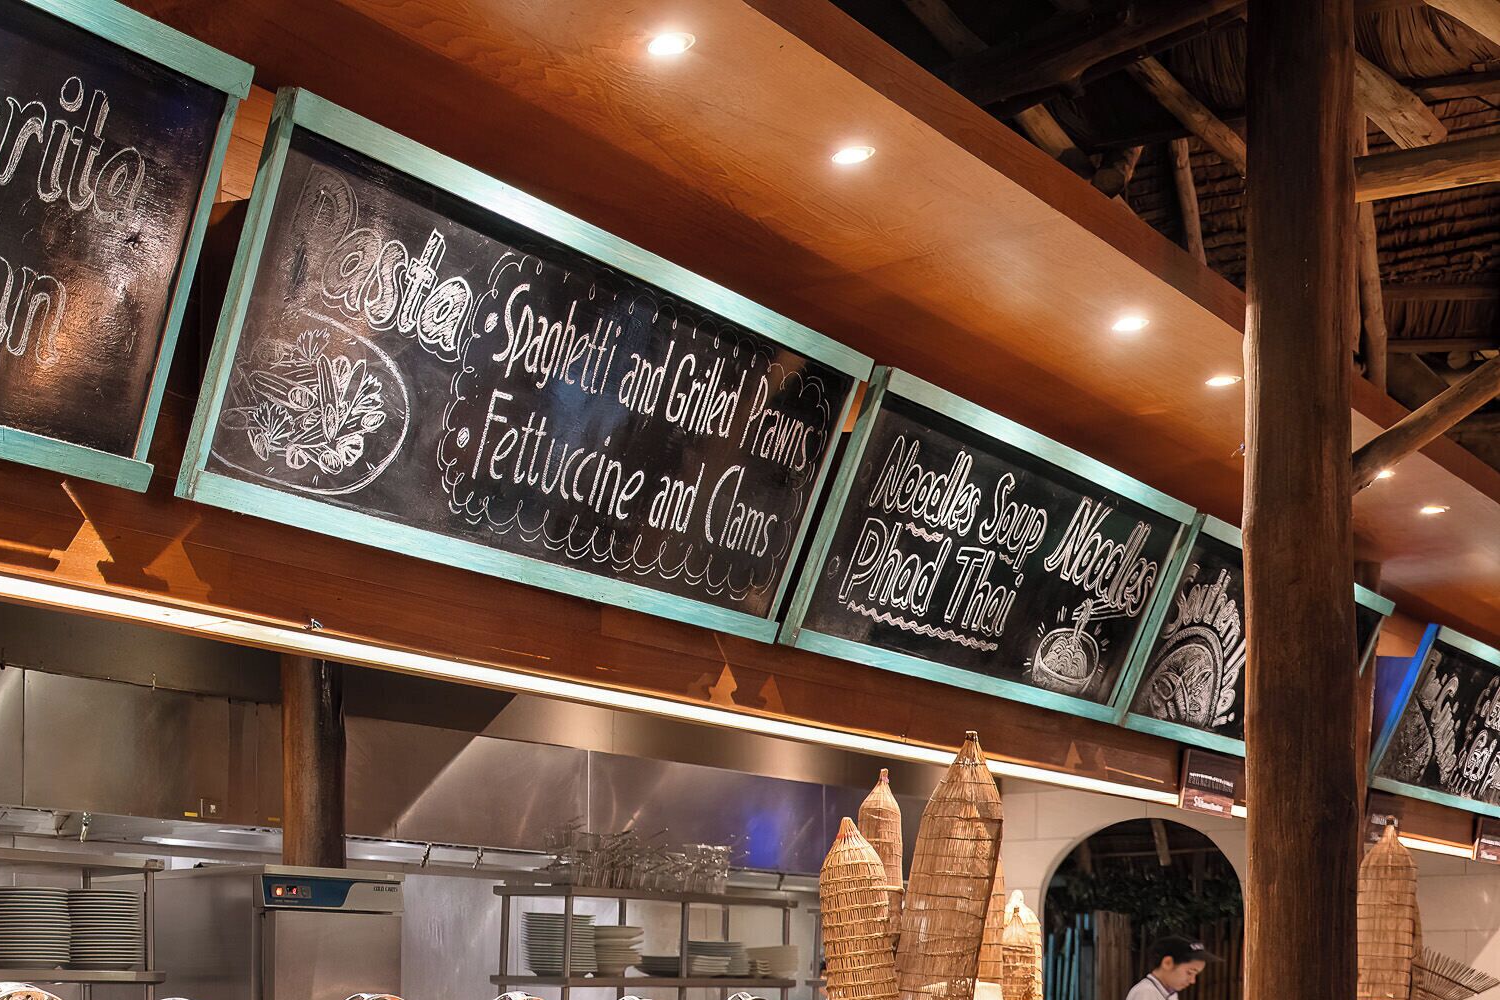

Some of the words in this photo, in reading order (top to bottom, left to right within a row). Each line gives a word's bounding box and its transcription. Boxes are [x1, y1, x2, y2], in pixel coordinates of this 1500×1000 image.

[288, 164, 474, 361] Pasta
[492, 283, 622, 395] Spaghetti
[618, 340, 676, 417] and
[666, 353, 748, 439] Grilled
[739, 374, 814, 472] Prawns
[471, 388, 645, 520] Fettuccine
[648, 462, 706, 534] and
[704, 464, 778, 558] Clams
[869, 435, 982, 537] Noodles
[978, 472, 1048, 573] Soup
[838, 517, 953, 617] Phad
[944, 546, 1023, 637] Thai
[1044, 496, 1158, 618] Noodles
